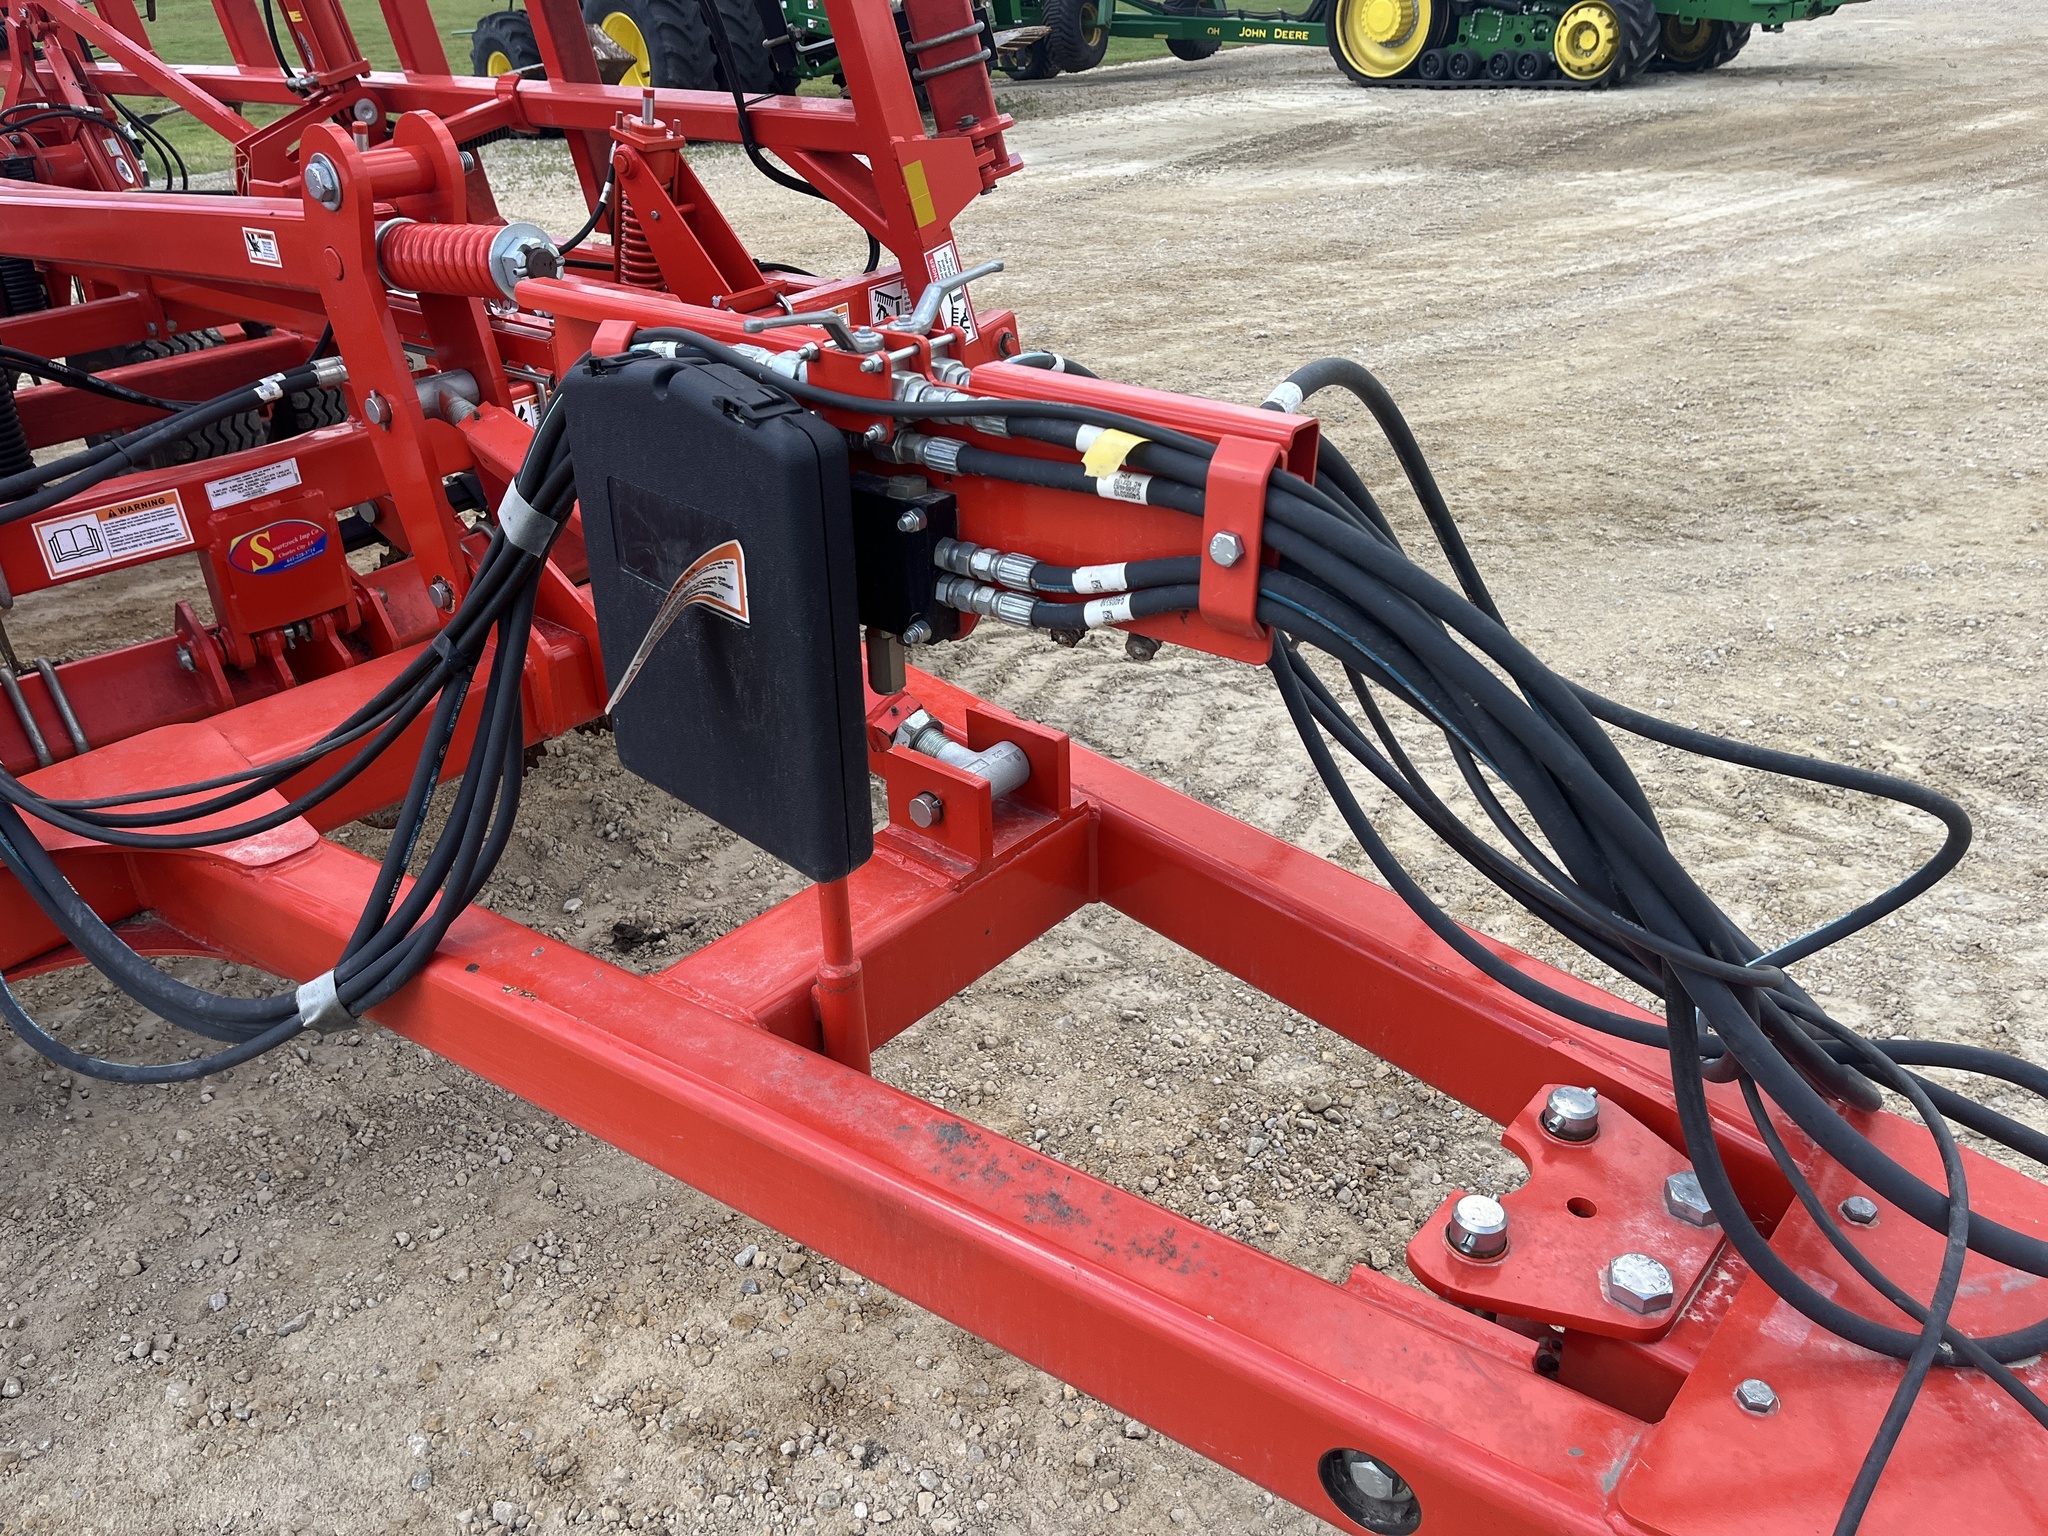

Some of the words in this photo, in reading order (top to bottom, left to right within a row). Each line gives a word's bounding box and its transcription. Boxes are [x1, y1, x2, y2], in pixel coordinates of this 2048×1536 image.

[1239, 27, 1267, 38] JOHN
[1274, 28, 1309, 40] DEERE
[118, 498, 166, 514] WARNING
[311, 528, 319, 536] Co
[278, 548, 296, 558] Charles
